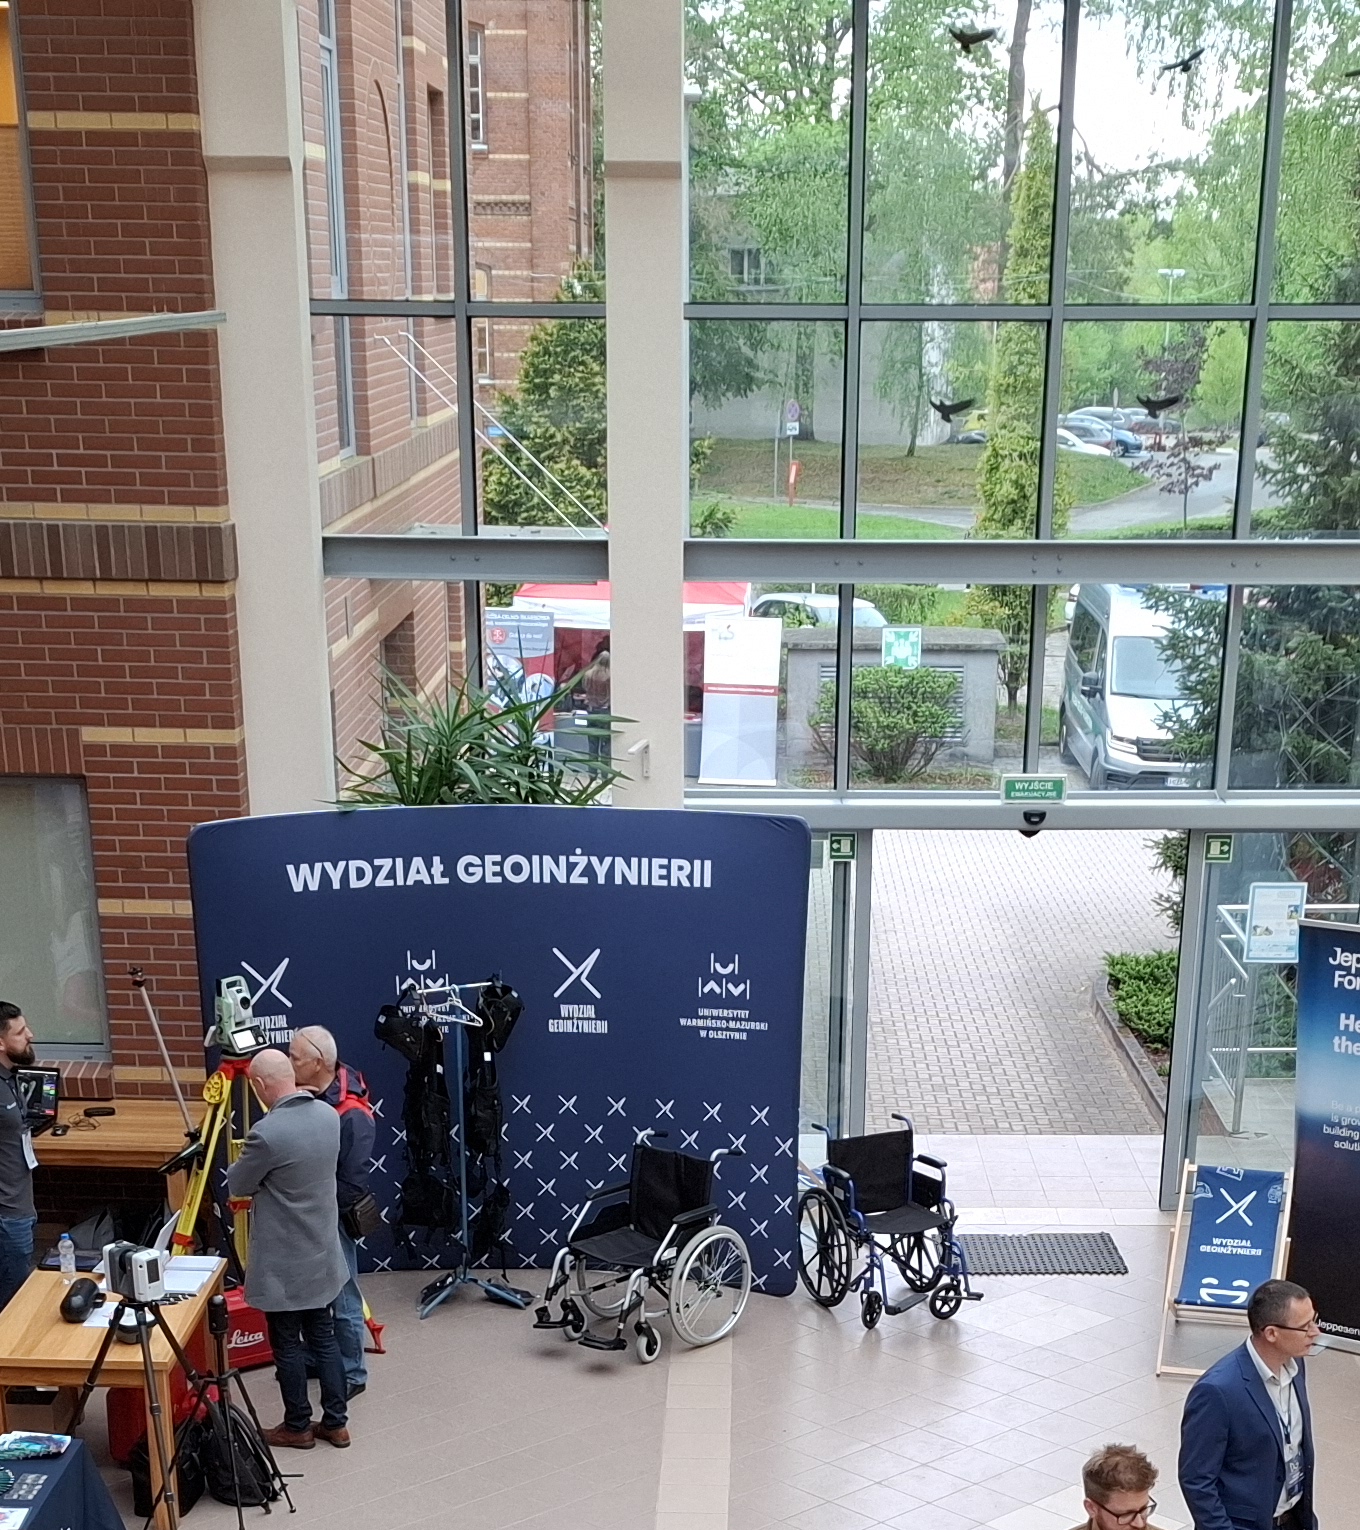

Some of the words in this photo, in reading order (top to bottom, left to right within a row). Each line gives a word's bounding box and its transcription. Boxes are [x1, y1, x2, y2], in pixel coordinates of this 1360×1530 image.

[1015, 780, 1054, 790] WYJŚCIE
[286, 854, 450, 893] WYDZIAŁ
[456, 847, 713, 888] GEOINŻYNIERII
[560, 1004, 596, 1018] WYDZIAŁ
[698, 1008, 750, 1019] UNIWERSYTET
[548, 1018, 608, 1034] GEOINŻYNIERII
[679, 1018, 769, 1031] WARMIŃSKO-MAZURSKI
[699, 1030, 707, 1038] W
[708, 1030, 747, 1040] OLSZTYNIE
[1331, 1100, 1343, 1111] Be
[1347, 1104, 1352, 1112] a
[1331, 1112, 1339, 1122] is
[1323, 1124, 1360, 1140] building
[1212, 1237, 1252, 1248] WYDZIAŁ
[227, 1329, 265, 1348] Leica
